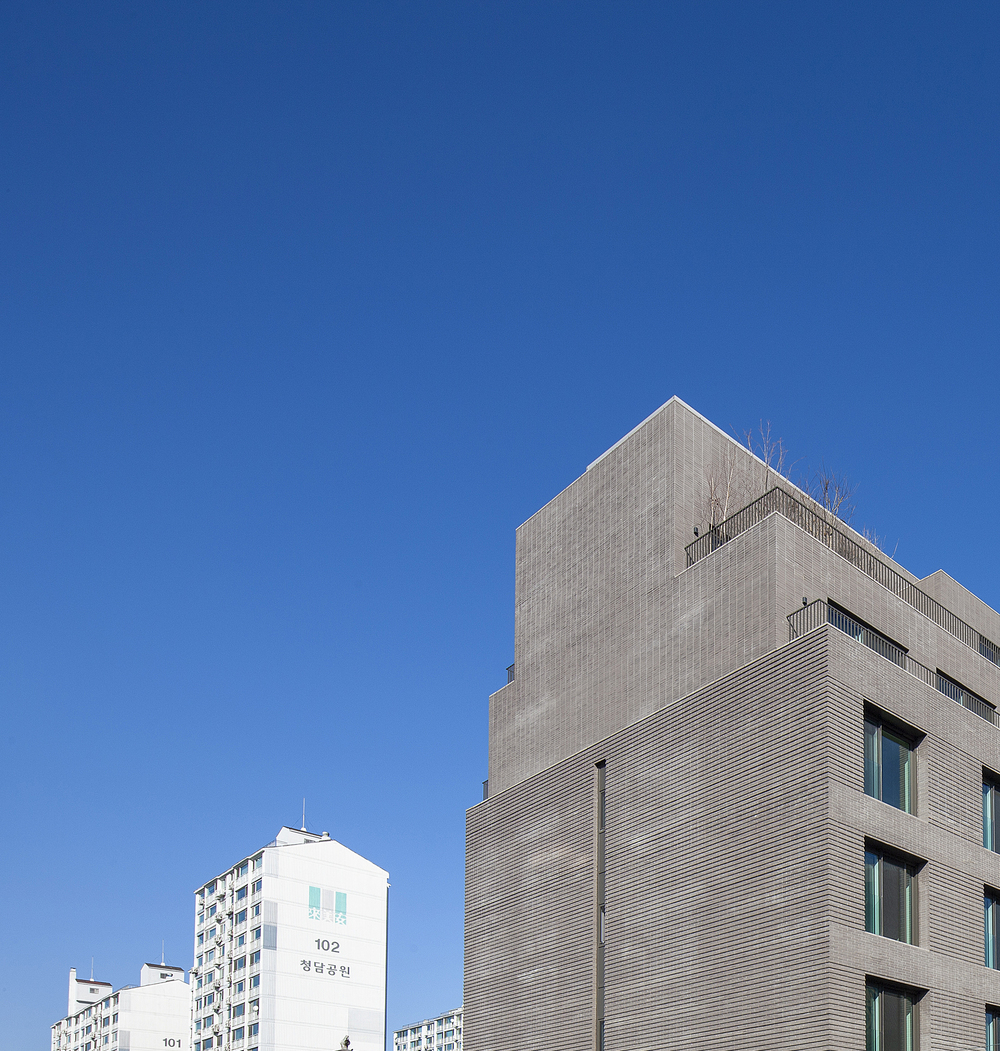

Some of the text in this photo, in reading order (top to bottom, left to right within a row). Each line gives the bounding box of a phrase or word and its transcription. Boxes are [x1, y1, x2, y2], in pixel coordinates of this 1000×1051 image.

[315, 938, 340, 954] 102
[300, 959, 350, 978] 청담공원
[163, 1038, 181, 1048] 101
